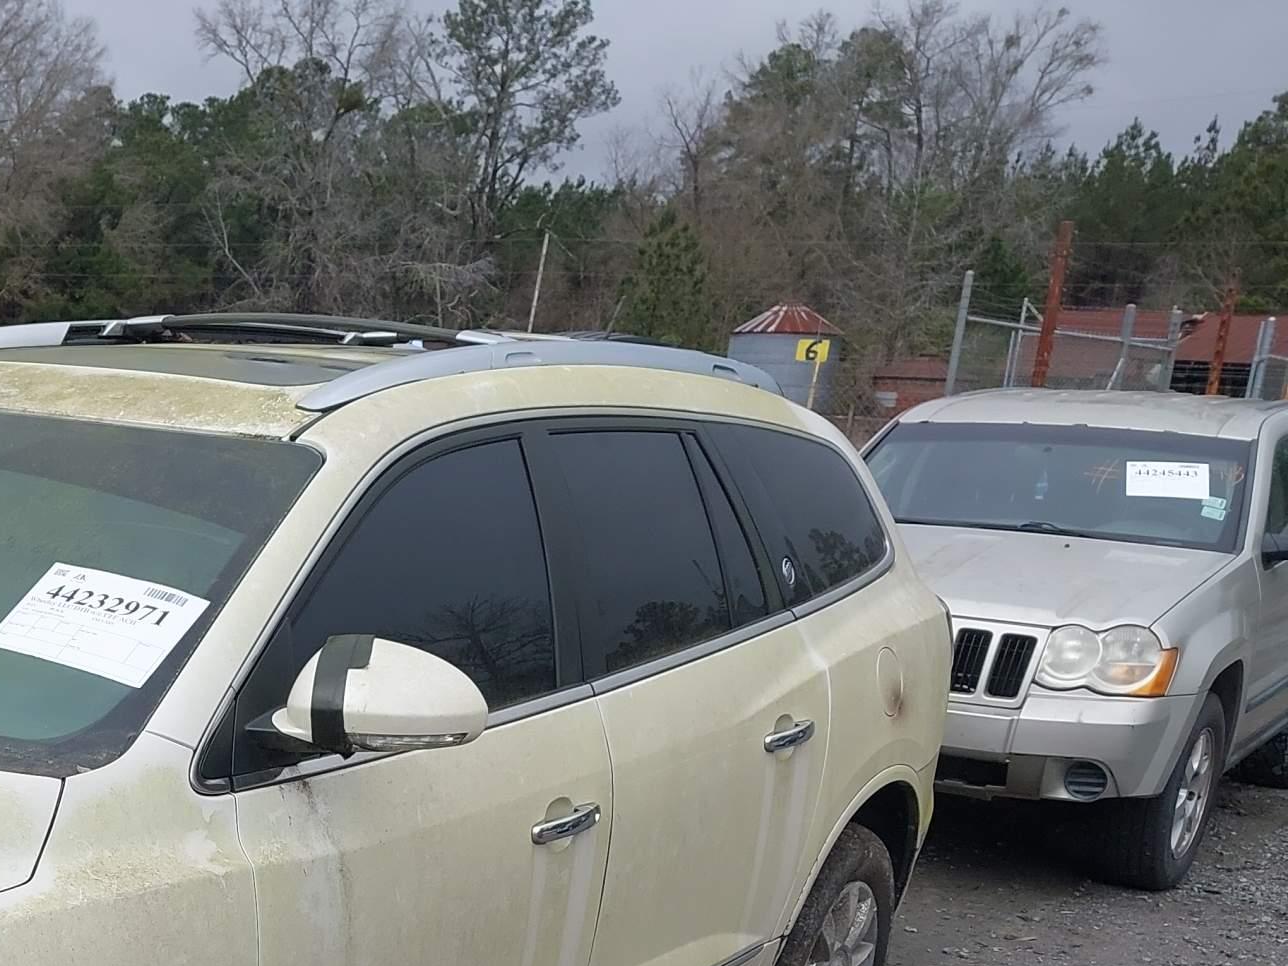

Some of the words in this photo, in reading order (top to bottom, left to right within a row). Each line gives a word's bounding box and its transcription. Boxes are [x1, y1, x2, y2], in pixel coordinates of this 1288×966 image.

[805, 340, 823, 361] 6
[1135, 468, 1198, 478] 44245443
[46, 584, 170, 626] 44232971
